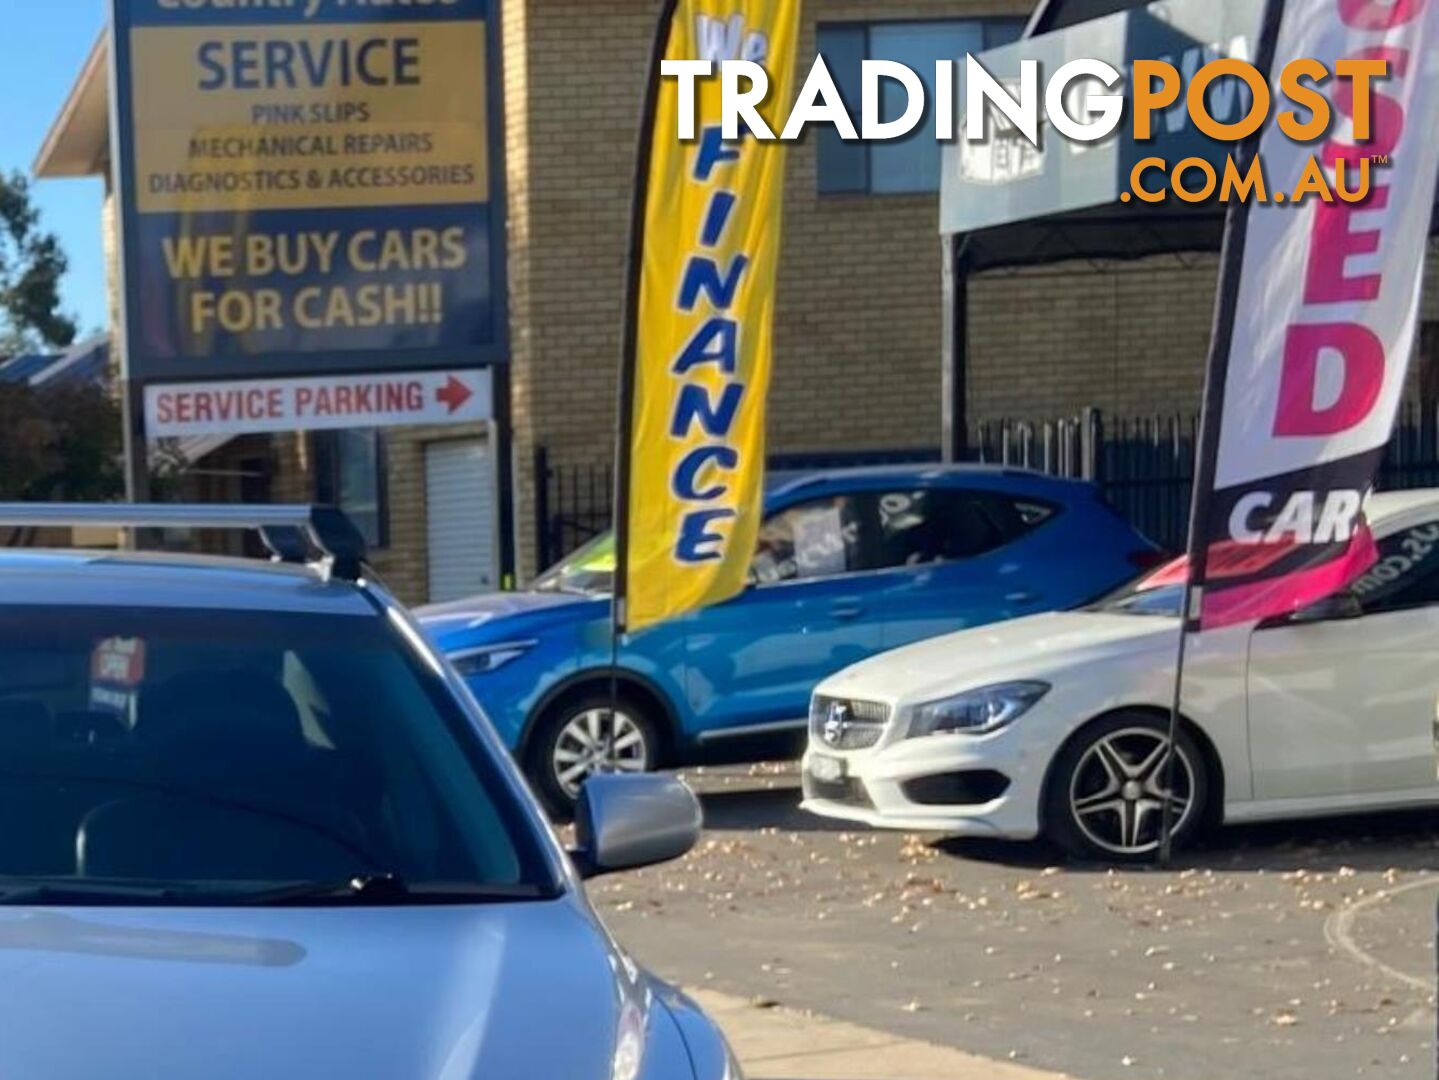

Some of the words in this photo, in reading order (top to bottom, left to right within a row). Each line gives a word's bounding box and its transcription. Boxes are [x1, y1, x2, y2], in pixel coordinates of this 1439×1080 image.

[197, 38, 420, 90] SERVICE
[696, 13, 768, 68] We
[252, 104, 302, 125] PINK
[308, 102, 370, 122] SLIPS
[189, 136, 338, 159] MECHANICAL
[344, 133, 432, 154] REPAIRS
[150, 171, 300, 193] DIAGNOSTICS
[306, 171, 321, 189] &
[328, 164, 474, 187] ACCESSORIES
[1271, 0, 1423, 439] SED
[164, 234, 235, 278] WE
[247, 231, 339, 274] BUY
[348, 227, 468, 272] CARS
[191, 288, 284, 333] FOR
[293, 283, 443, 328] CASH!!
[670, 125, 748, 562] FINANCE
[157, 386, 284, 423] SERVICE
[295, 382, 424, 416] PARKING
